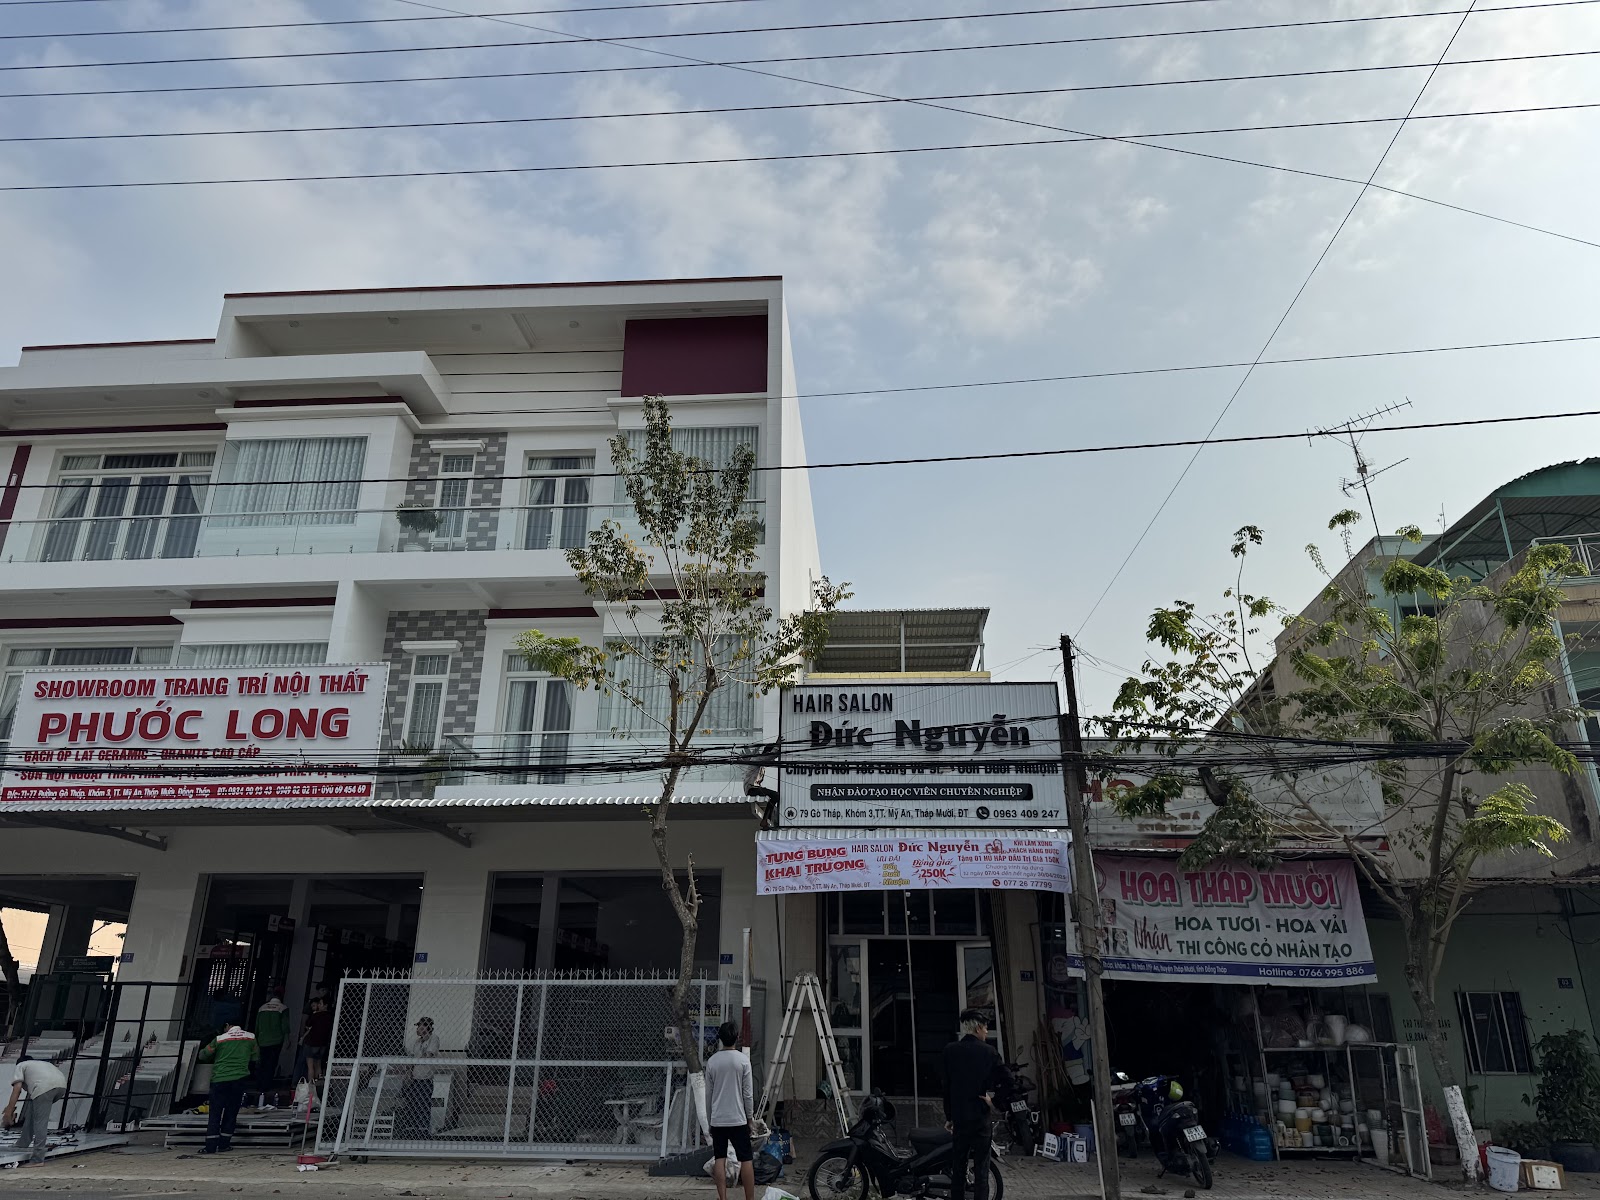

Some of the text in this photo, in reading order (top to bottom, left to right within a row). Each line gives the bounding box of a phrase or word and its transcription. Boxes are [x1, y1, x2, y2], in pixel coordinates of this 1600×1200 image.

[34, 668, 369, 698] SHOWROOM TRANG TRÍ NỘI THẤT
[793, 692, 893, 712] HAIR SALON
[37, 700, 349, 743] PHƯỚC LONG
[809, 713, 1030, 752] Đức Nguyễn
[88, 787, 105, 798] Khóm
[817, 787, 846, 797] NHẬN
[890, 788, 912, 798] HỌC
[912, 786, 938, 796] VIÊN
[939, 786, 981, 796] CHUYÊN
[983, 786, 1023, 798] NGHIỆP
[800, 809, 809, 818] 79
[810, 809, 821, 818] Gò
[823, 808, 843, 820] Tháp,
[845, 808, 867, 818] Khóm
[888, 807, 899, 820] Mỹ
[900, 809, 914, 819] An,
[915, 808, 934, 819] Tháp
[957, 808, 969, 818] ĐT
[993, 809, 1018, 818] 0963
[1020, 809, 1039, 818] 409
[1041, 809, 1060, 818] 247
[851, 840, 979, 854] HAIR SALON Đức Nguyễn
[765, 865, 801, 881] KHAI
[921, 868, 947, 878] 250K
[1003, 879, 1017, 887] 077
[1119, 870, 1181, 904] HOA
[1184, 863, 1255, 905] THÁP
[1175, 914, 1348, 934] HOA TƯƠI HOA VẢI
[1134, 916, 1172, 955] Nhận
[1176, 937, 1353, 963] THI CÔNG CỎ NHÂN TẠO
[1258, 966, 1365, 977] Hotline: 0766 995 886
